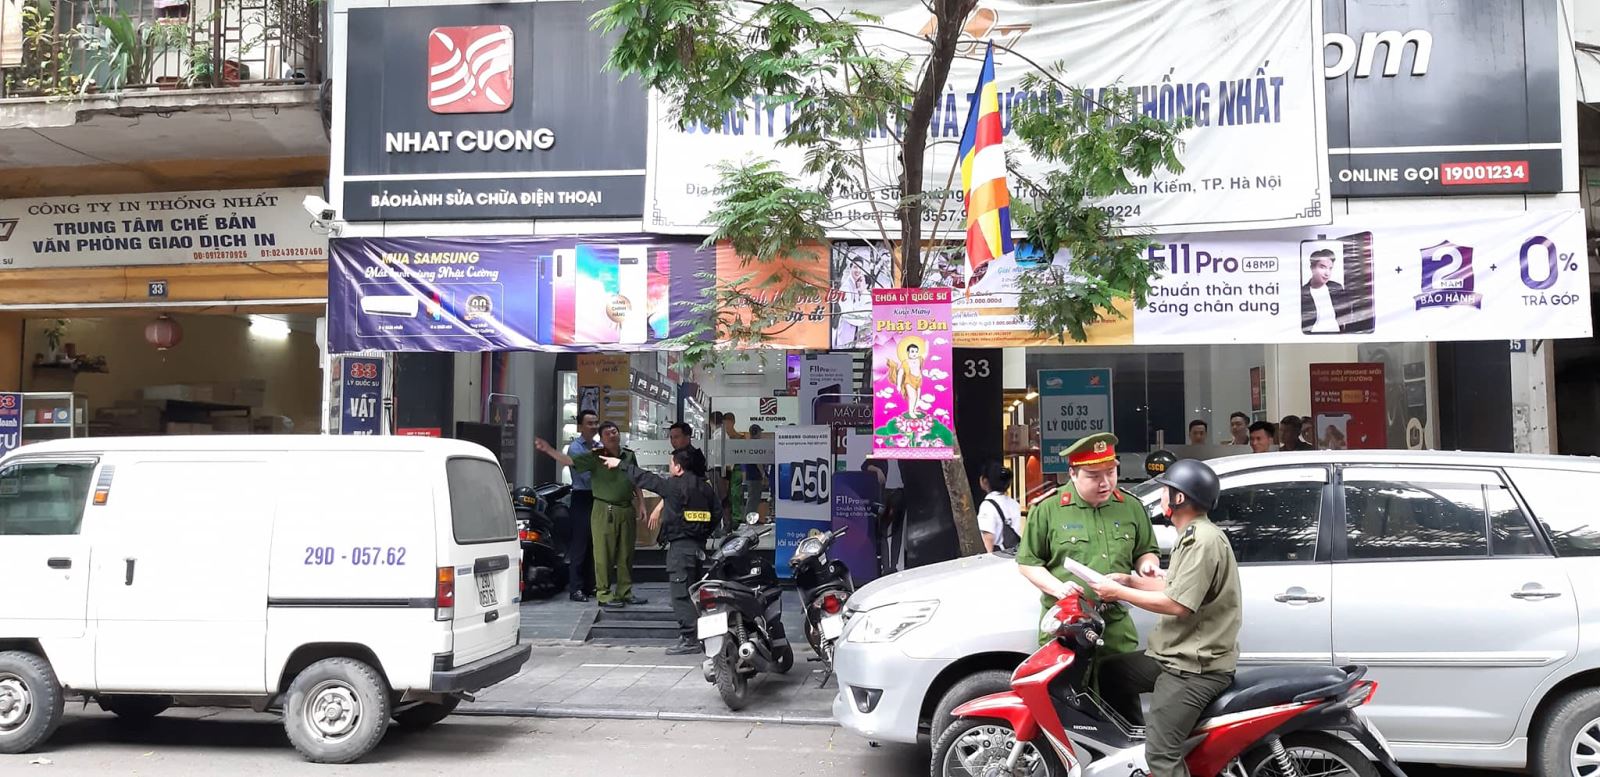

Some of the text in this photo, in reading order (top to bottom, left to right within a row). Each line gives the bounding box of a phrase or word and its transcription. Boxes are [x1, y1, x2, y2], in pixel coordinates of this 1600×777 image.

[1217, 60, 1283, 126] NHẤT
[385, 128, 555, 153] NHAT CUONG
[1338, 165, 1525, 184] ONLINE GỌI 19001234
[686, 183, 708, 197] Địa
[1154, 178, 1196, 194] Kiếm,
[1201, 179, 1224, 190] TP.
[1229, 176, 1250, 189] Hà
[1256, 175, 1282, 190] Nội
[28, 192, 279, 215] CÔNG TY IN THỐNG NHẤT
[446, 189, 473, 207] SỬA
[476, 188, 518, 206] CHỮA
[520, 188, 554, 207] ĐIỆN
[557, 190, 602, 207] THOẠI
[54, 211, 256, 235] TRUNG TÂM CHẾ BẢN
[33, 233, 276, 253] VĂN PHÒNG GIAO DỊCH IN
[414, 252, 480, 264] SAMSUNG
[1196, 251, 1239, 273] Pro
[1246, 260, 1276, 269] 48MP
[1432, 246, 1462, 288] 2
[152, 283, 163, 295] 33
[1150, 281, 1280, 297] Chuẩn thần thái
[1149, 300, 1280, 316] Sáng chân dung
[1522, 292, 1580, 306] TRẢ GÓP
[876, 319, 912, 334] Phật
[350, 362, 377, 378] 33
[964, 359, 990, 378] 33
[350, 394, 376, 422] VẬT
[834, 405, 856, 418] MÁY
[1060, 402, 1088, 416] SỐ 33
[1047, 417, 1104, 431] LÝ QUỐC SƯ
[791, 462, 829, 500] A50
[304, 546, 335, 565] 29D
[352, 547, 406, 565] 057.62
